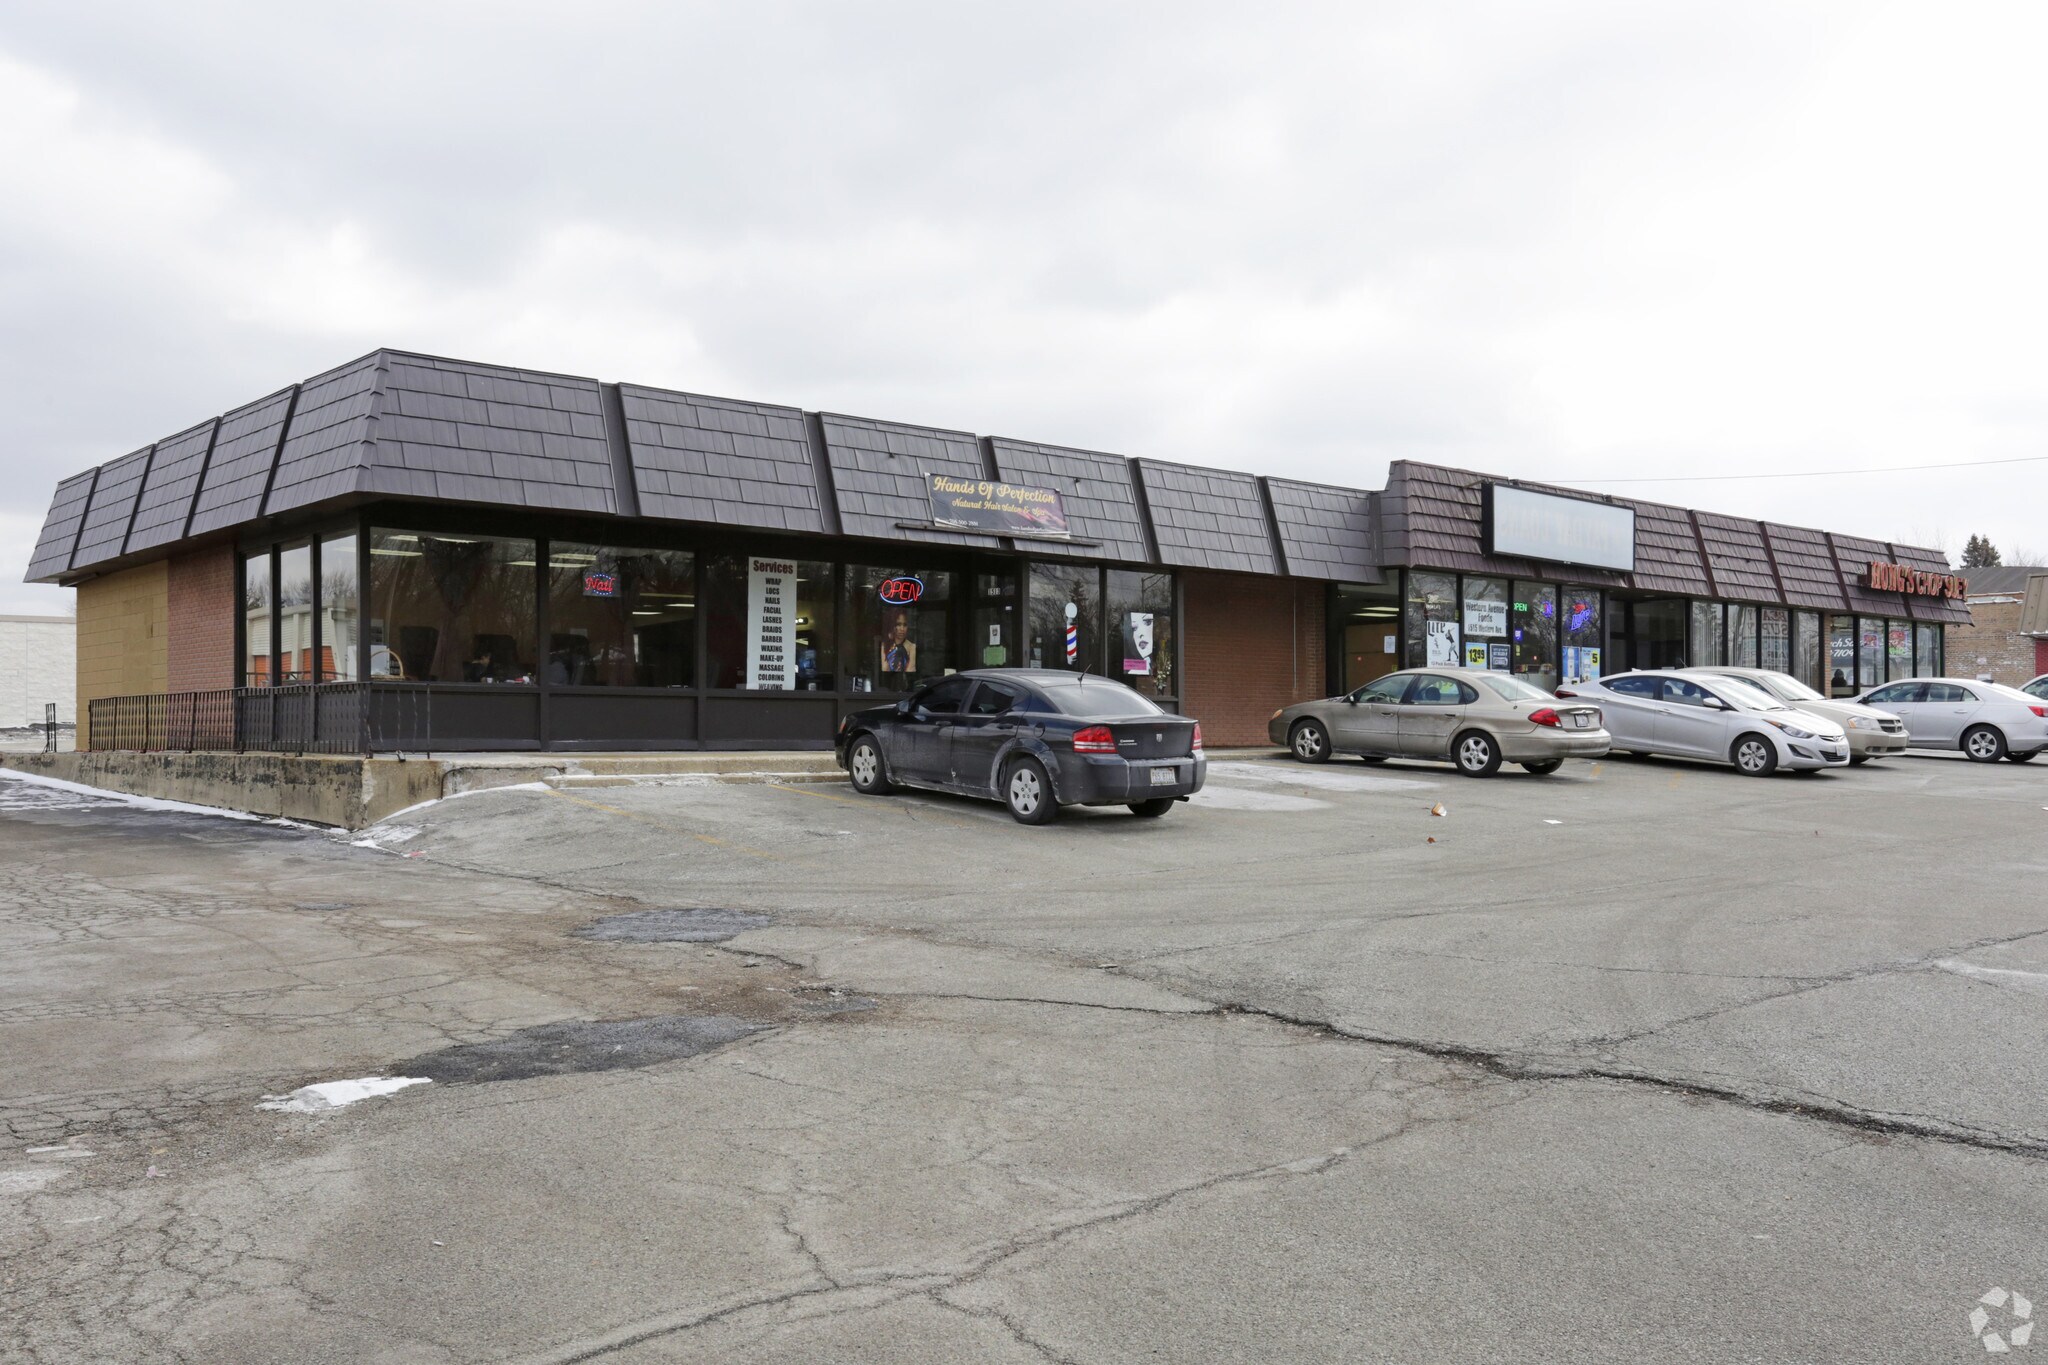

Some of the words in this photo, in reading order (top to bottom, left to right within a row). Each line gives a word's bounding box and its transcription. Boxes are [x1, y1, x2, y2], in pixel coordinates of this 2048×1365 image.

[933, 476, 975, 495] Hands
[978, 481, 994, 500] Of
[996, 484, 1056, 504] Perfection
[952, 497, 982, 509] Natural
[983, 501, 1001, 511] Hair
[1001, 503, 1022, 513] Salon
[753, 560, 793, 574] Services
[765, 577, 782, 586] WRAP
[1871, 560, 1915, 594] HONG'S
[1916, 571, 1942, 596] CHOP
[584, 577, 616, 592] Nail
[765, 587, 780, 595] LOCS
[881, 579, 920, 601] OPEN
[764, 596, 780, 605] NAILS
[763, 606, 782, 615] FACIAL
[762, 616, 782, 624] LASHES
[762, 625, 782, 633] BRAIDS
[761, 635, 783, 643] BARBER
[760, 645, 782, 653] WAXING
[759, 654, 784, 662] MAKE-UP
[758, 664, 784, 672] MASSAGE
[757, 673, 784, 681] COLORING
